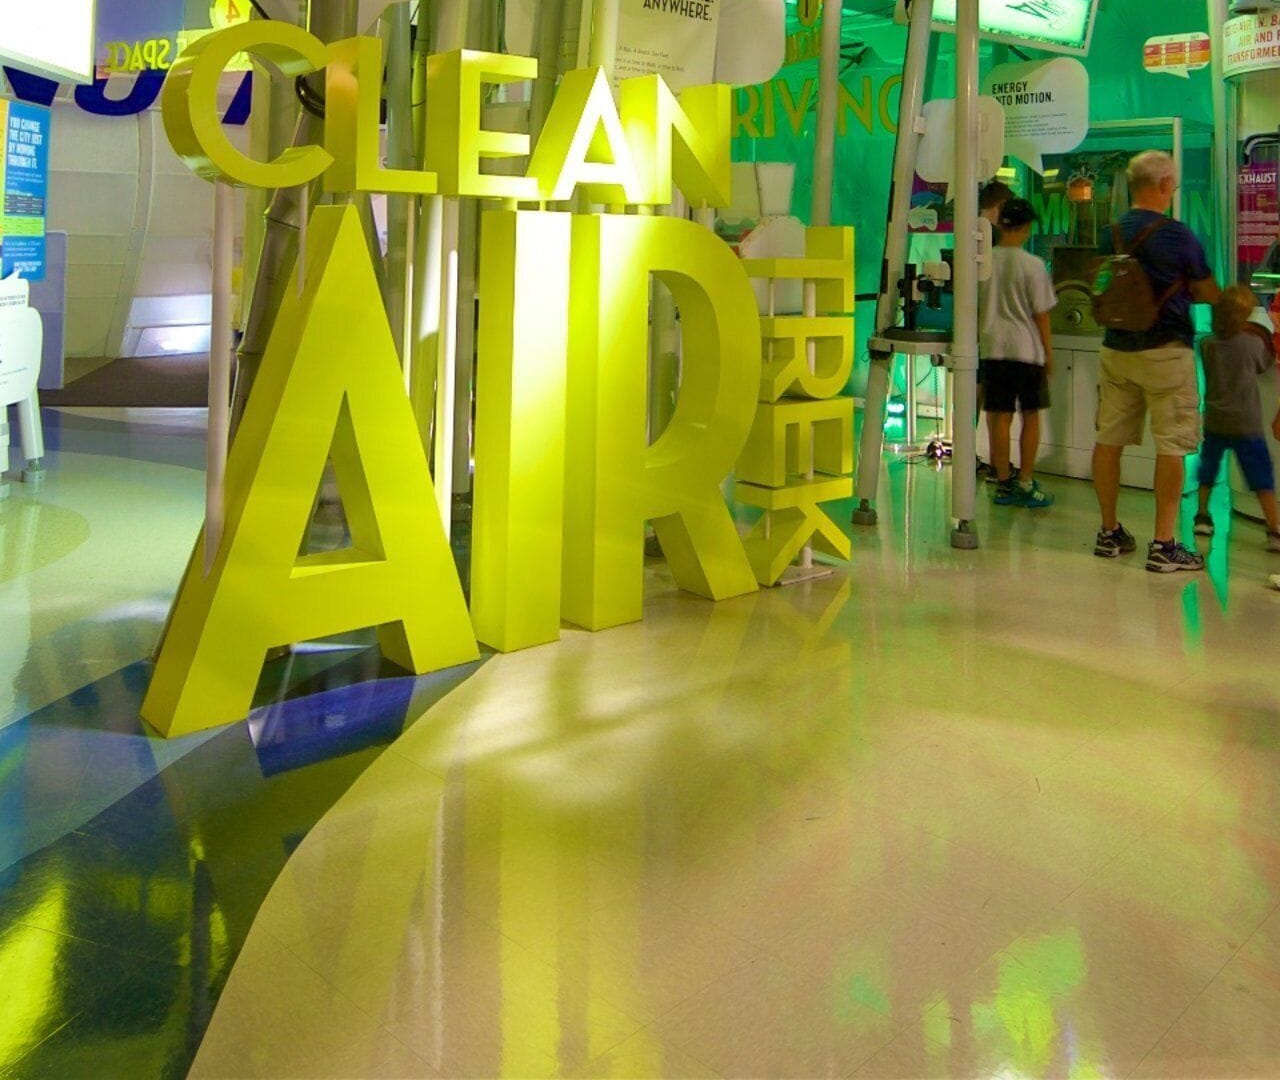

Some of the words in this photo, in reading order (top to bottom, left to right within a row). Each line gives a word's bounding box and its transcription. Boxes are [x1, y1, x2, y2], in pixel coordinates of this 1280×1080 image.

[161, 20, 732, 207] CLEAN
[992, 81, 1028, 95] ENERGY
[1015, 91, 1054, 105] MOTION.
[1239, 172, 1276, 185] EXHAUST
[736, 226, 855, 587] TREK
[140, 203, 760, 738] AIR
